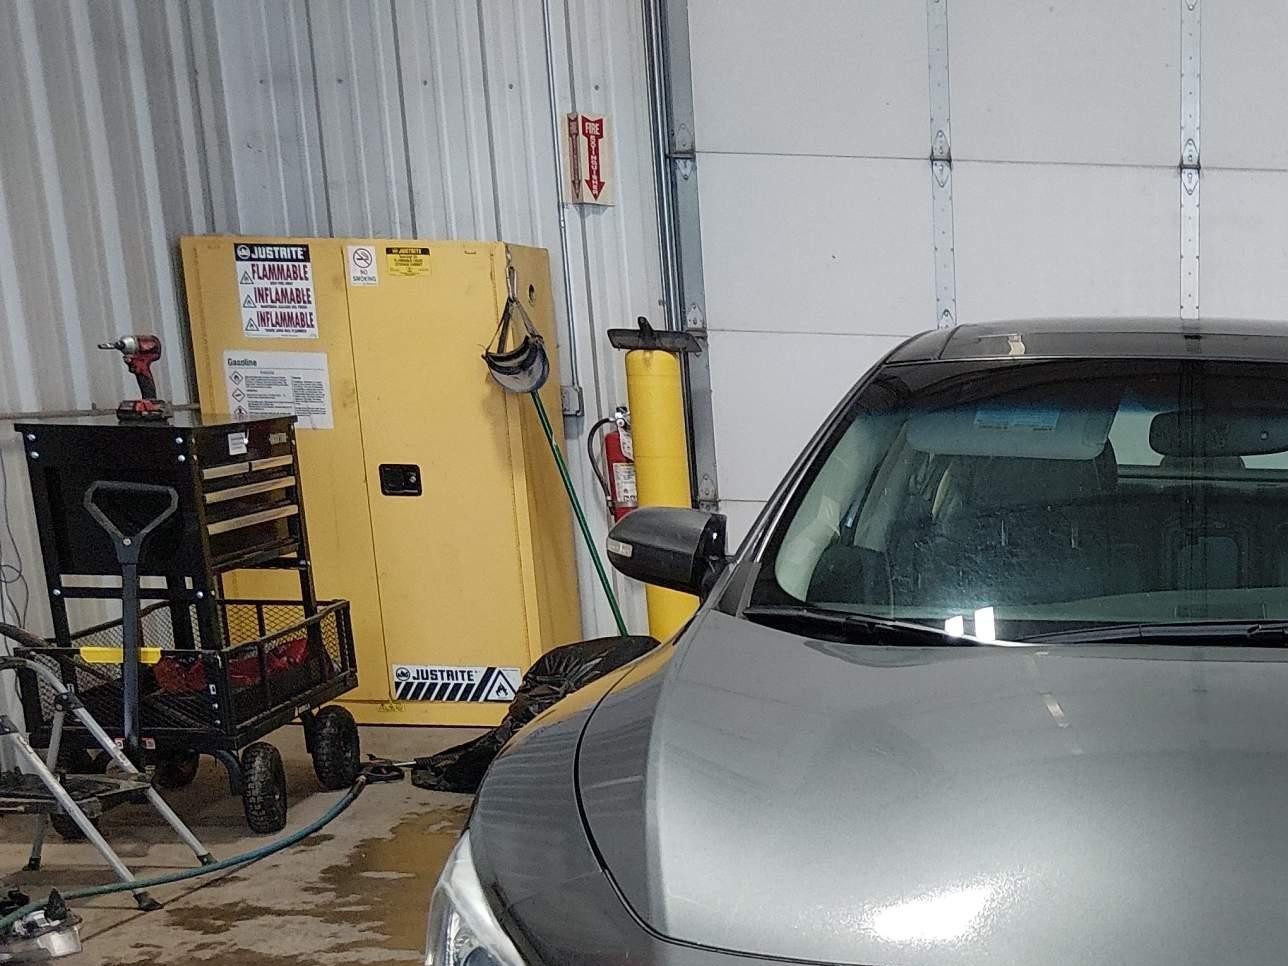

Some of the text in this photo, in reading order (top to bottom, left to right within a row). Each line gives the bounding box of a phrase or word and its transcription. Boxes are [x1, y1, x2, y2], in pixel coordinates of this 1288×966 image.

[585, 122, 600, 135] FIRE
[251, 247, 304, 259] JUSTRITE
[251, 264, 309, 281] FLAMMABLE
[253, 287, 312, 305] INFLAMABLE
[256, 311, 315, 329] INFLAMMABLE
[227, 358, 257, 367] Gasoline
[412, 669, 474, 681] JUSTRITE
